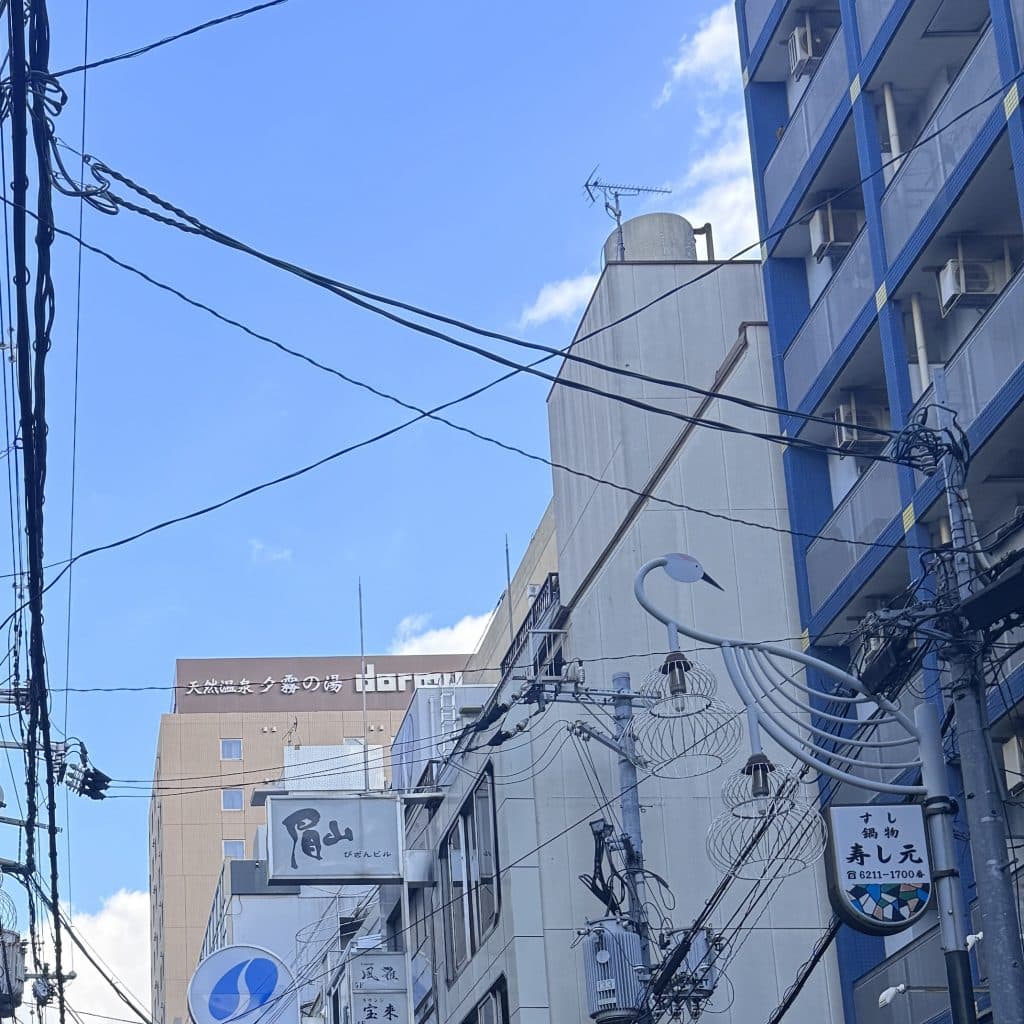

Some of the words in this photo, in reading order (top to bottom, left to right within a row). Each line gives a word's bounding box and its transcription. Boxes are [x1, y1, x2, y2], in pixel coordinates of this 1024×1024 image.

[185, 678, 254, 695] 天然温泉
[859, 811, 897, 824] すし
[861, 826, 899, 839] 鍋物
[846, 843, 923, 866] 寿し元
